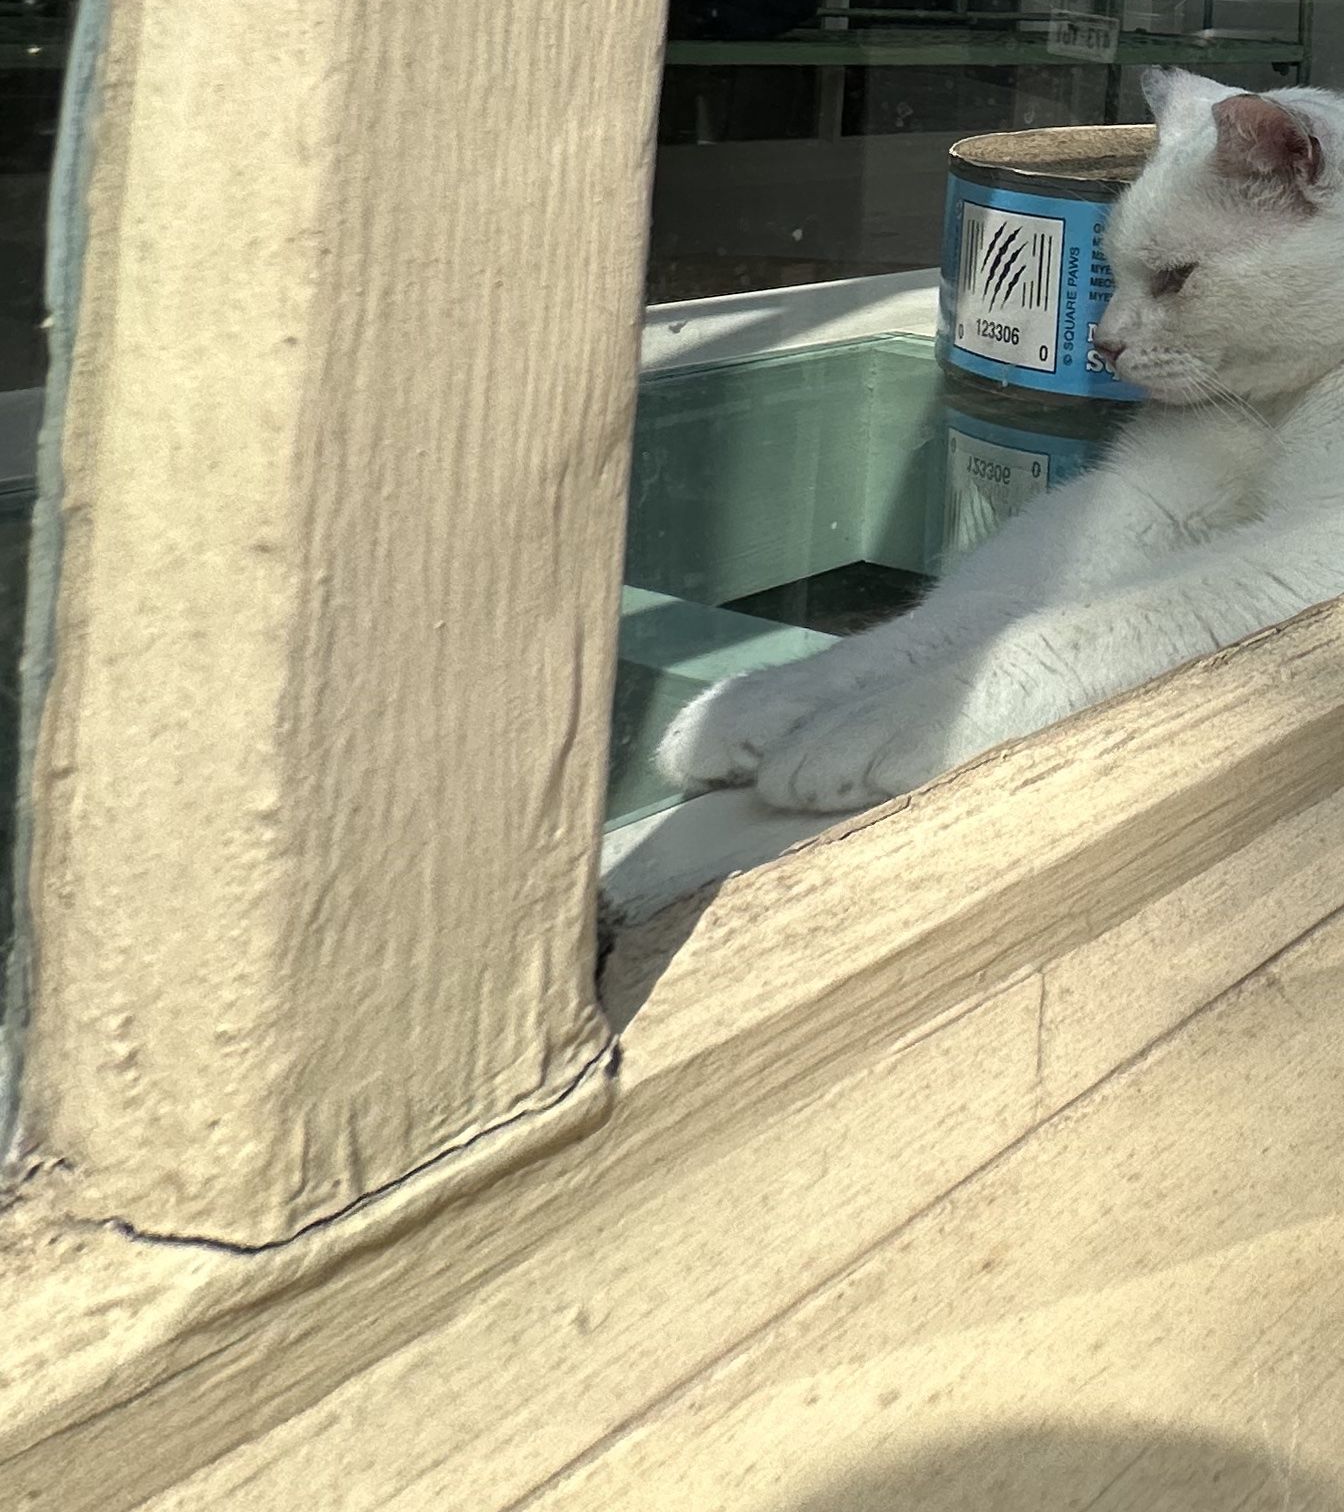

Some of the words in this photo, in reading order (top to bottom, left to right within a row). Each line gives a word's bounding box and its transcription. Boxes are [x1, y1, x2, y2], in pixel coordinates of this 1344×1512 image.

[1068, 246, 1080, 287] PAWS
[976, 318, 1020, 345] 123306
[1039, 345, 1048, 361] 0
[1063, 290, 1077, 351] SQUARE
